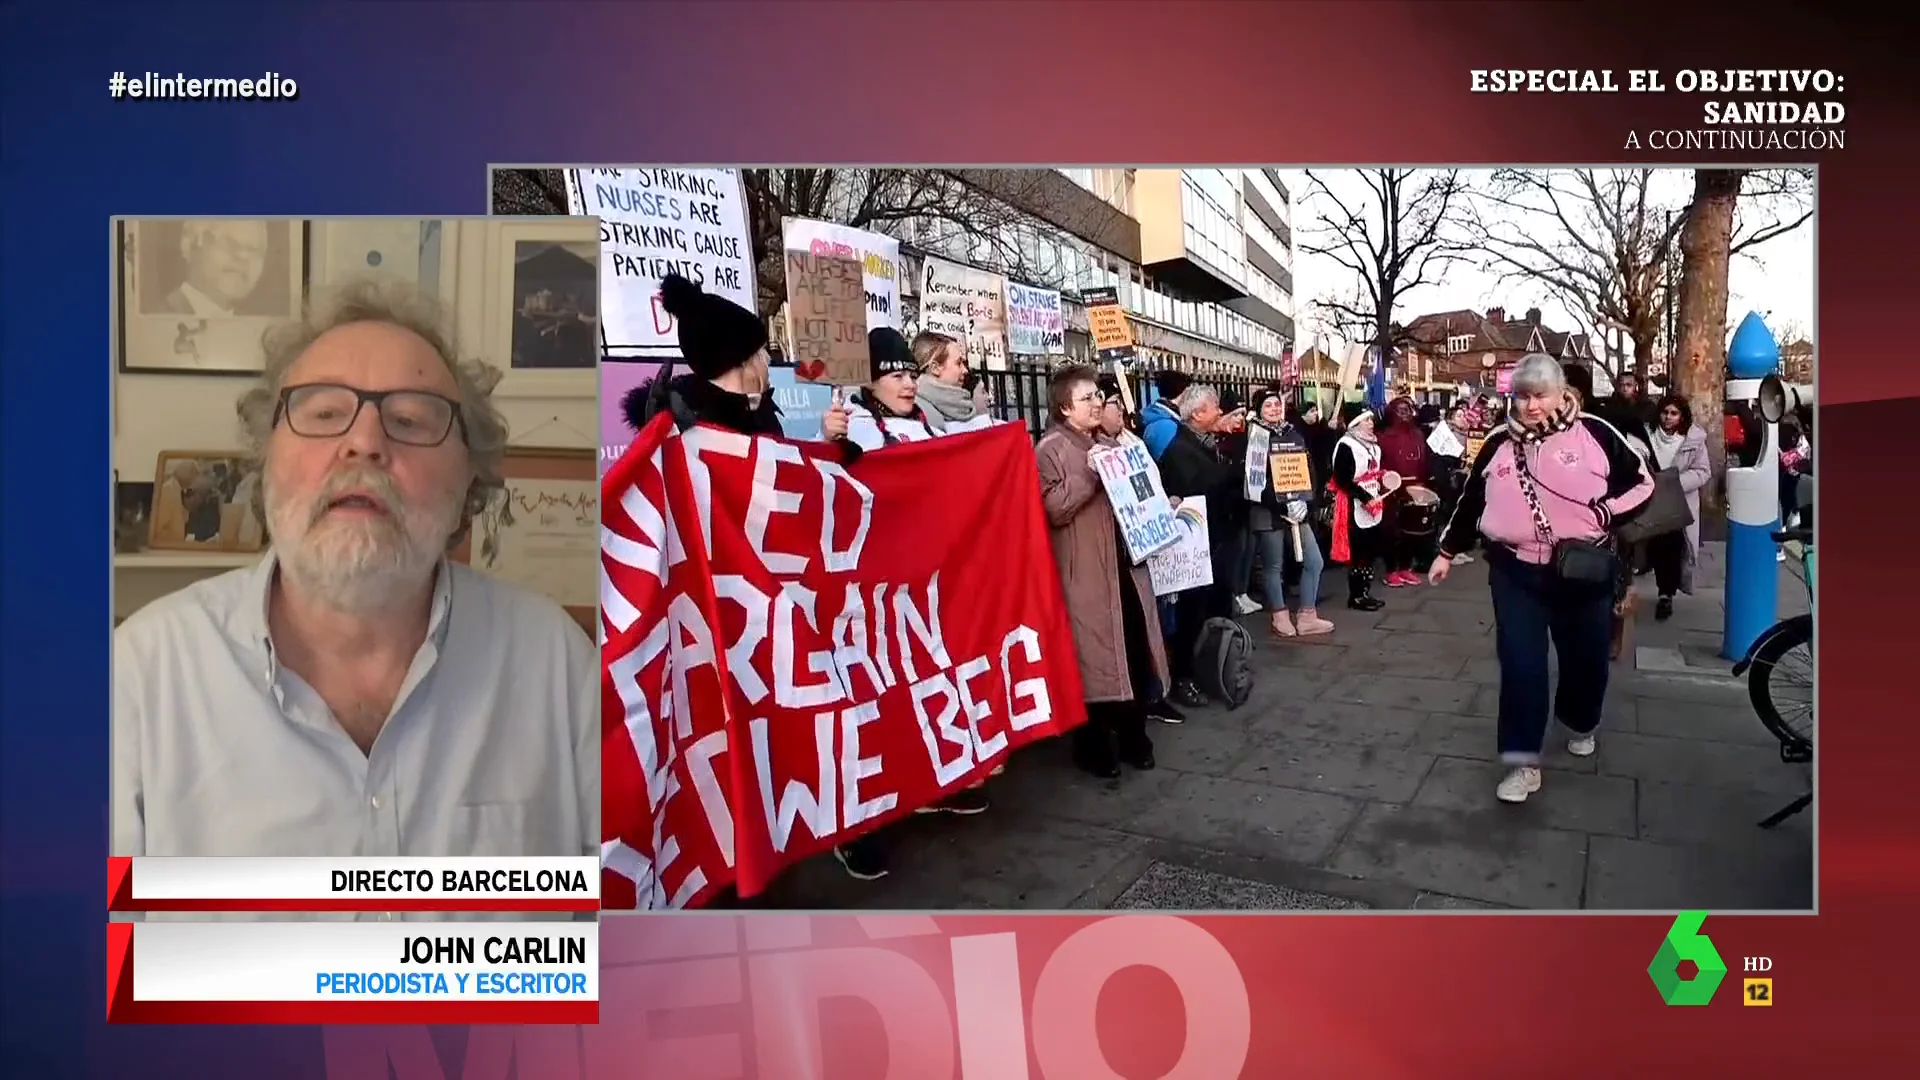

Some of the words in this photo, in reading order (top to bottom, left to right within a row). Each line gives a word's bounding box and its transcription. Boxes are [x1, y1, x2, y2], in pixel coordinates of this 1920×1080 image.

[595, 183, 682, 221] NURSES
[689, 200, 722, 225] ARE
[600, 220, 687, 252] STRIKING
[694, 232, 741, 259] CAUSE
[613, 254, 704, 285] PATIENTS
[715, 265, 741, 290] ARE
[967, 302, 993, 320] Boris
[748, 699, 899, 853] WE
[910, 624, 1053, 788] BEG
